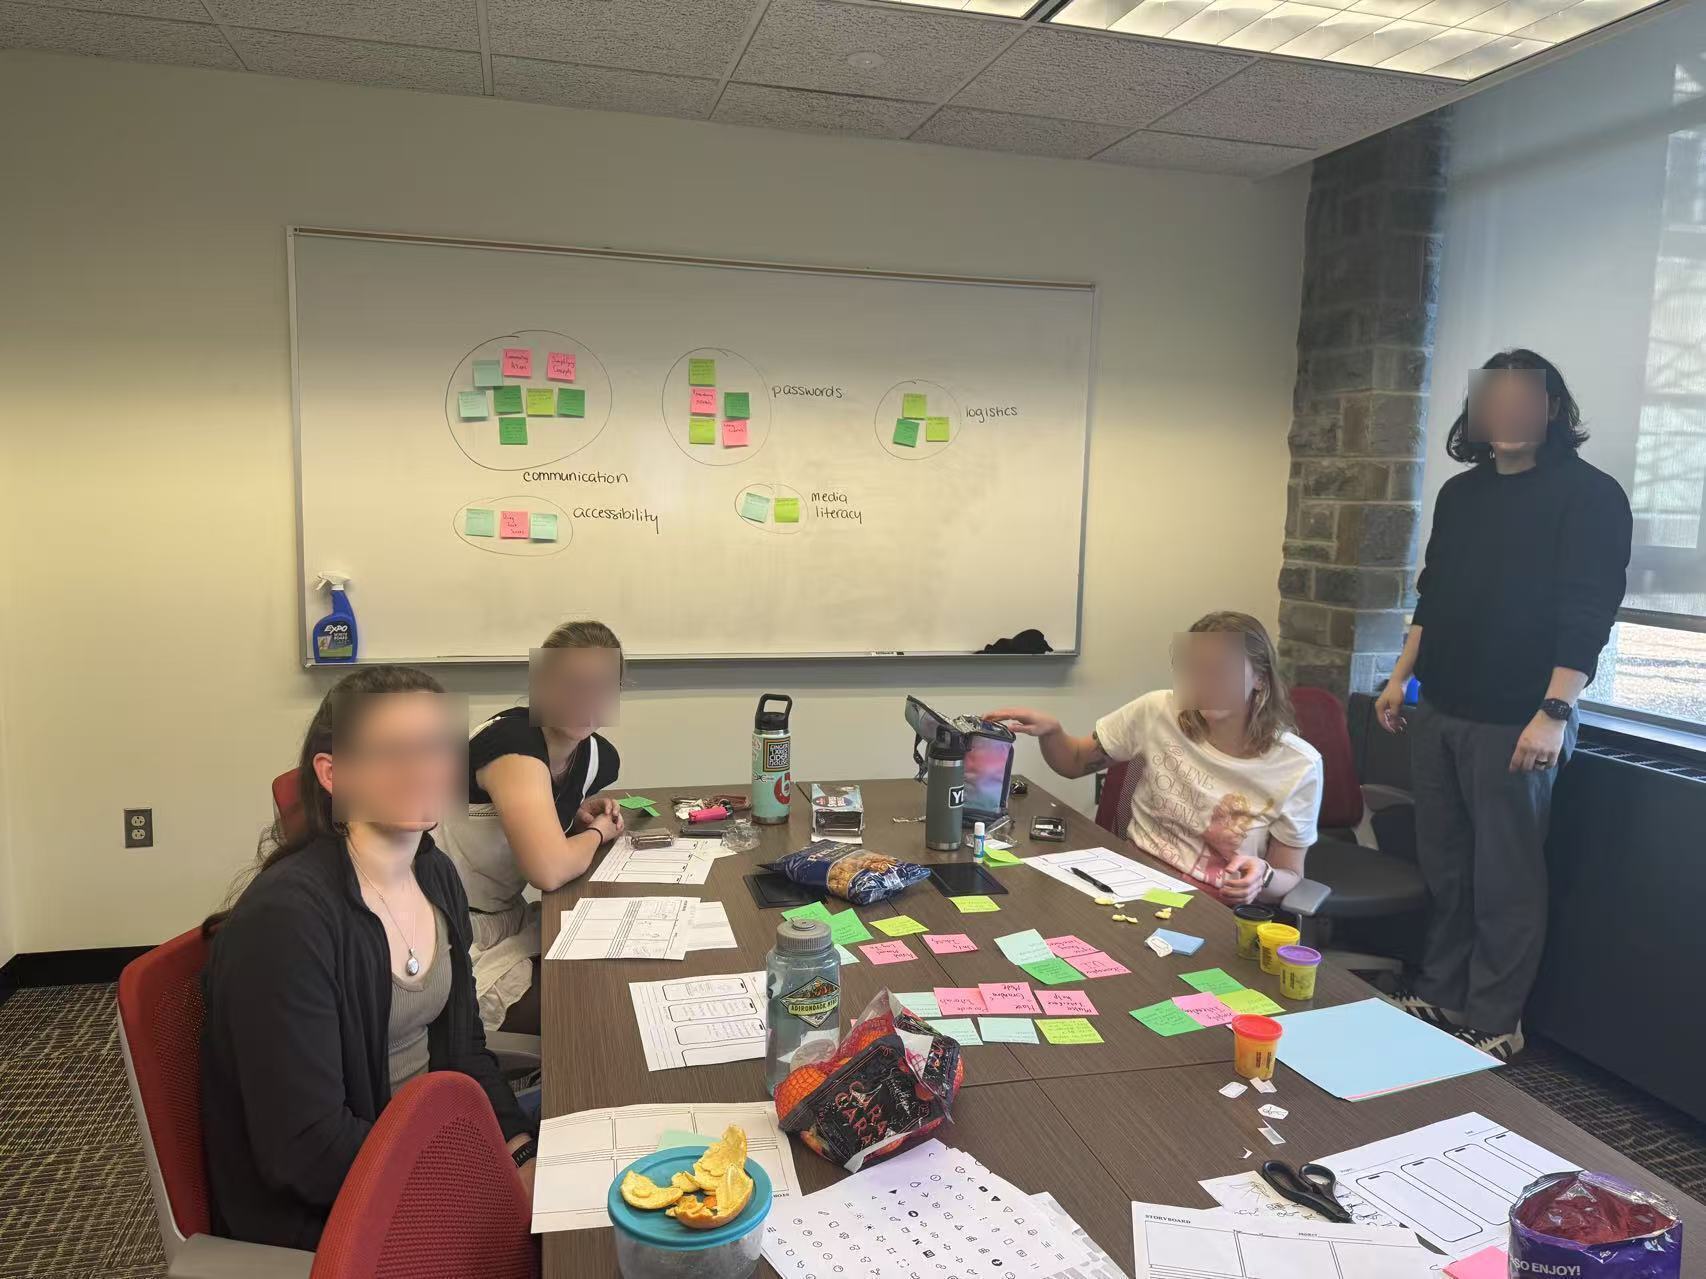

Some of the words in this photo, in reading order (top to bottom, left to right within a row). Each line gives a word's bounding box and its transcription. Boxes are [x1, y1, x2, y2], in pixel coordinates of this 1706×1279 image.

[771, 385, 843, 399] passwords
[965, 405, 1018, 423] logistics
[522, 470, 629, 484] communication
[810, 490, 848, 504] media
[572, 506, 659, 535] accessibility
[815, 505, 863, 525] literacy
[323, 624, 348, 635] EXPO
[790, 1002, 827, 1012] ADIRONDACK
[1015, 1004, 1036, 1012] Have
[1144, 1213, 1192, 1224] STORYBOARD
[1531, 1262, 1581, 1276] ENJOY!
